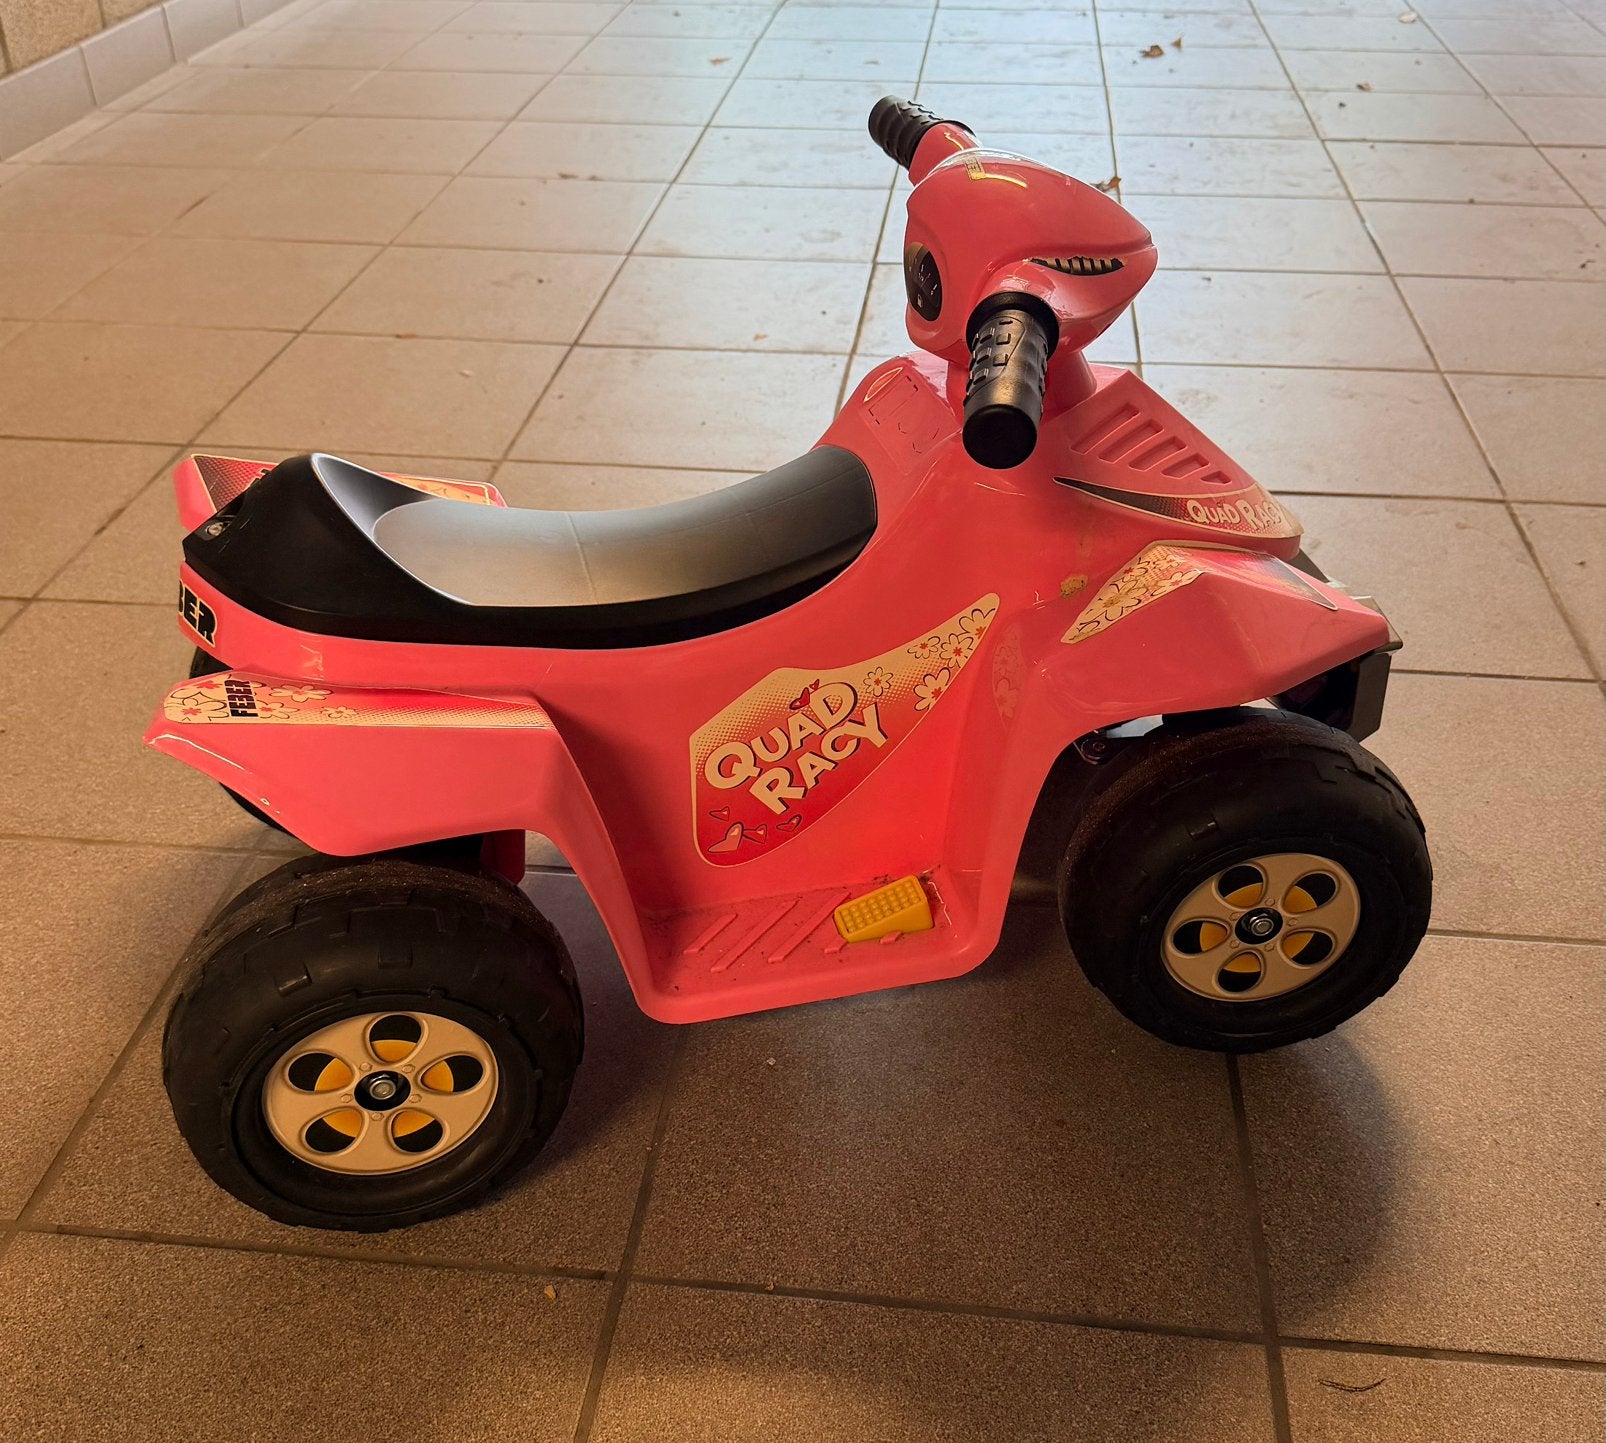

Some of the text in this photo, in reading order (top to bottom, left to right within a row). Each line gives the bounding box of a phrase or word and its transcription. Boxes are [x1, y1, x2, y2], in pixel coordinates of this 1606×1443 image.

[1186, 499, 1241, 525] QUAD
[223, 679, 259, 718] FEBER
[704, 682, 858, 789] QUAD
[748, 702, 888, 815] RACY
